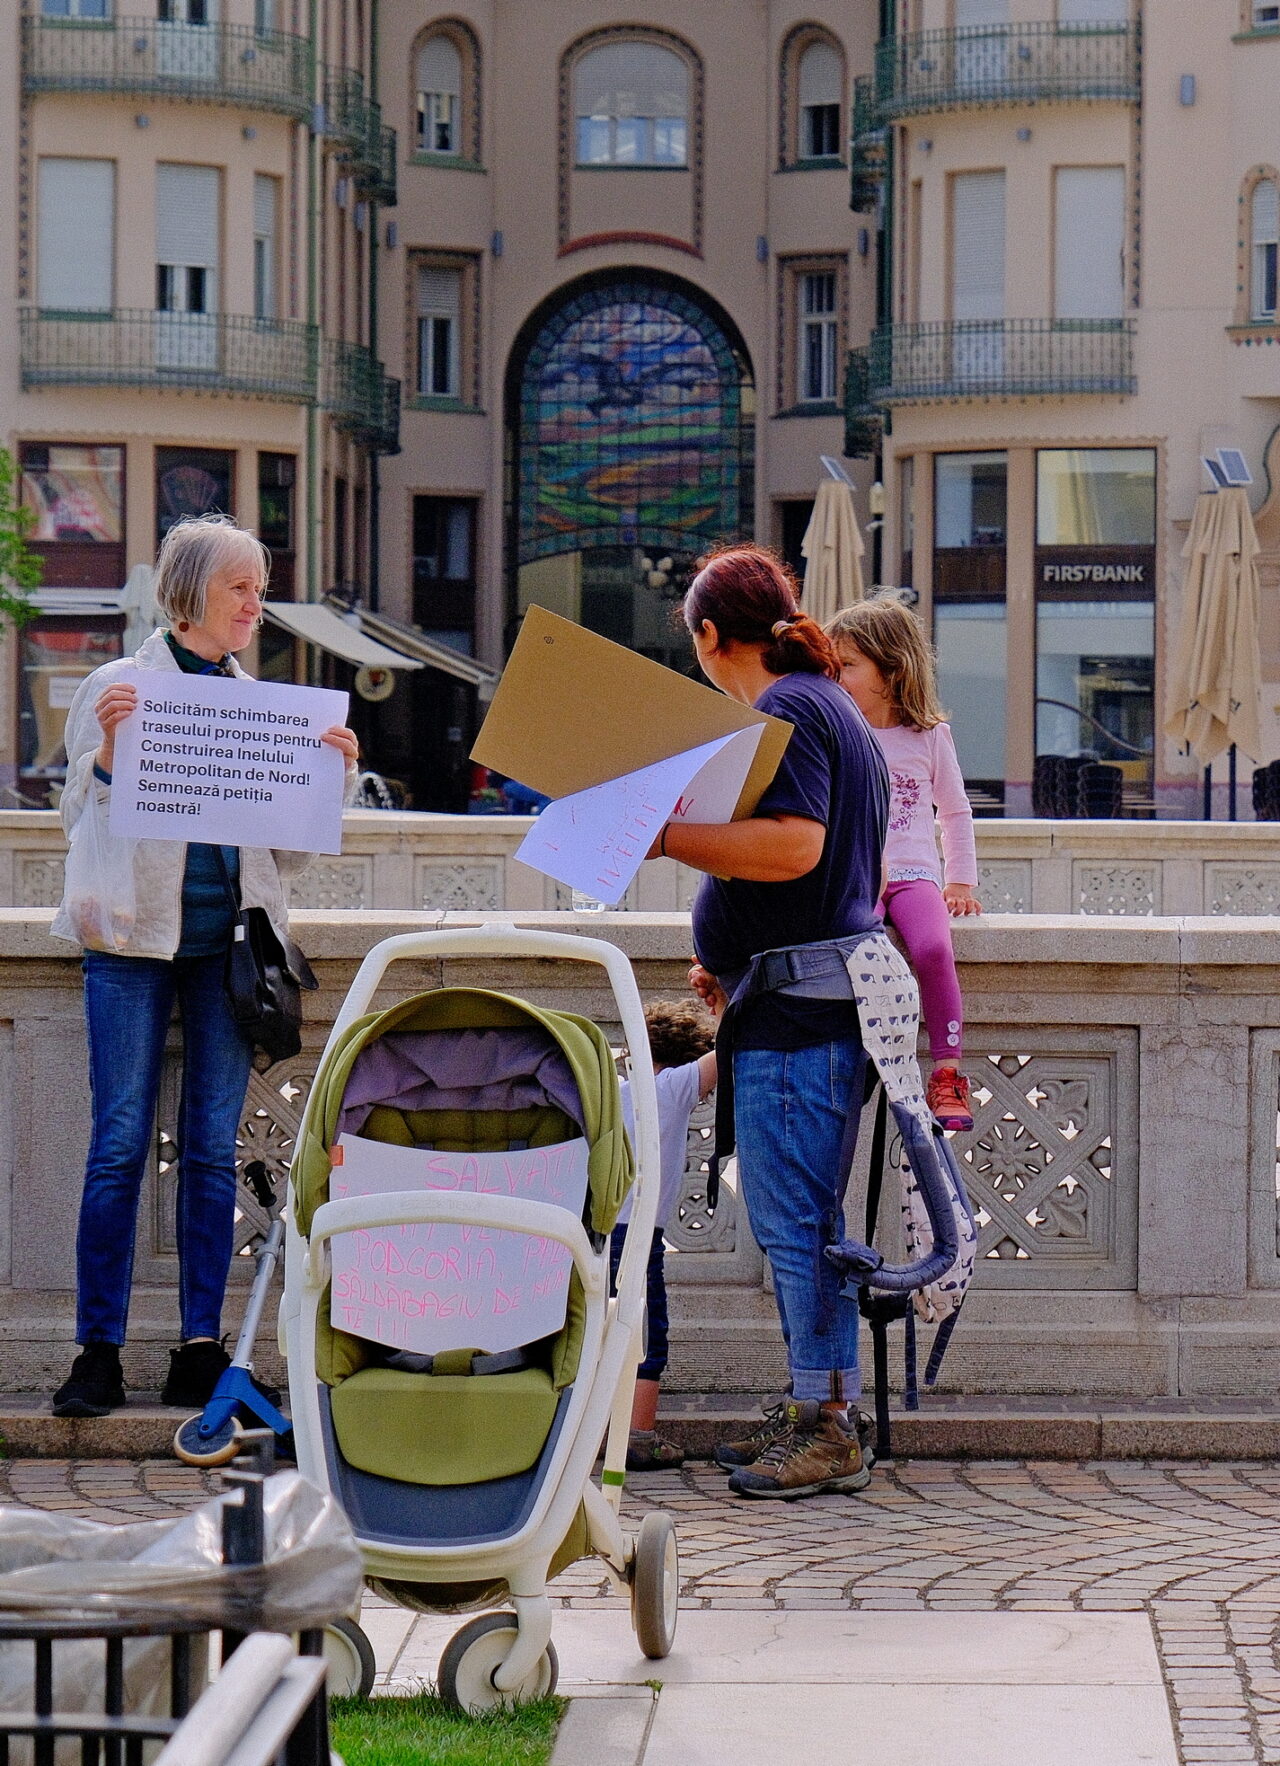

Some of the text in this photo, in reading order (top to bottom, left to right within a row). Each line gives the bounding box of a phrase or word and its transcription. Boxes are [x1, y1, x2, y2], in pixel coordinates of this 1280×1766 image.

[1043, 564, 1144, 581] FIRSTBANK
[142, 699, 310, 728] Solicităm schimbarea
[141, 719, 322, 748] traseului propus pentru
[140, 739, 294, 765] Construirea Inelului
[139, 759, 311, 786] Metropolitan de Nord!
[137, 779, 273, 804] Semnează petiția
[135, 800, 201, 816] noastră!
